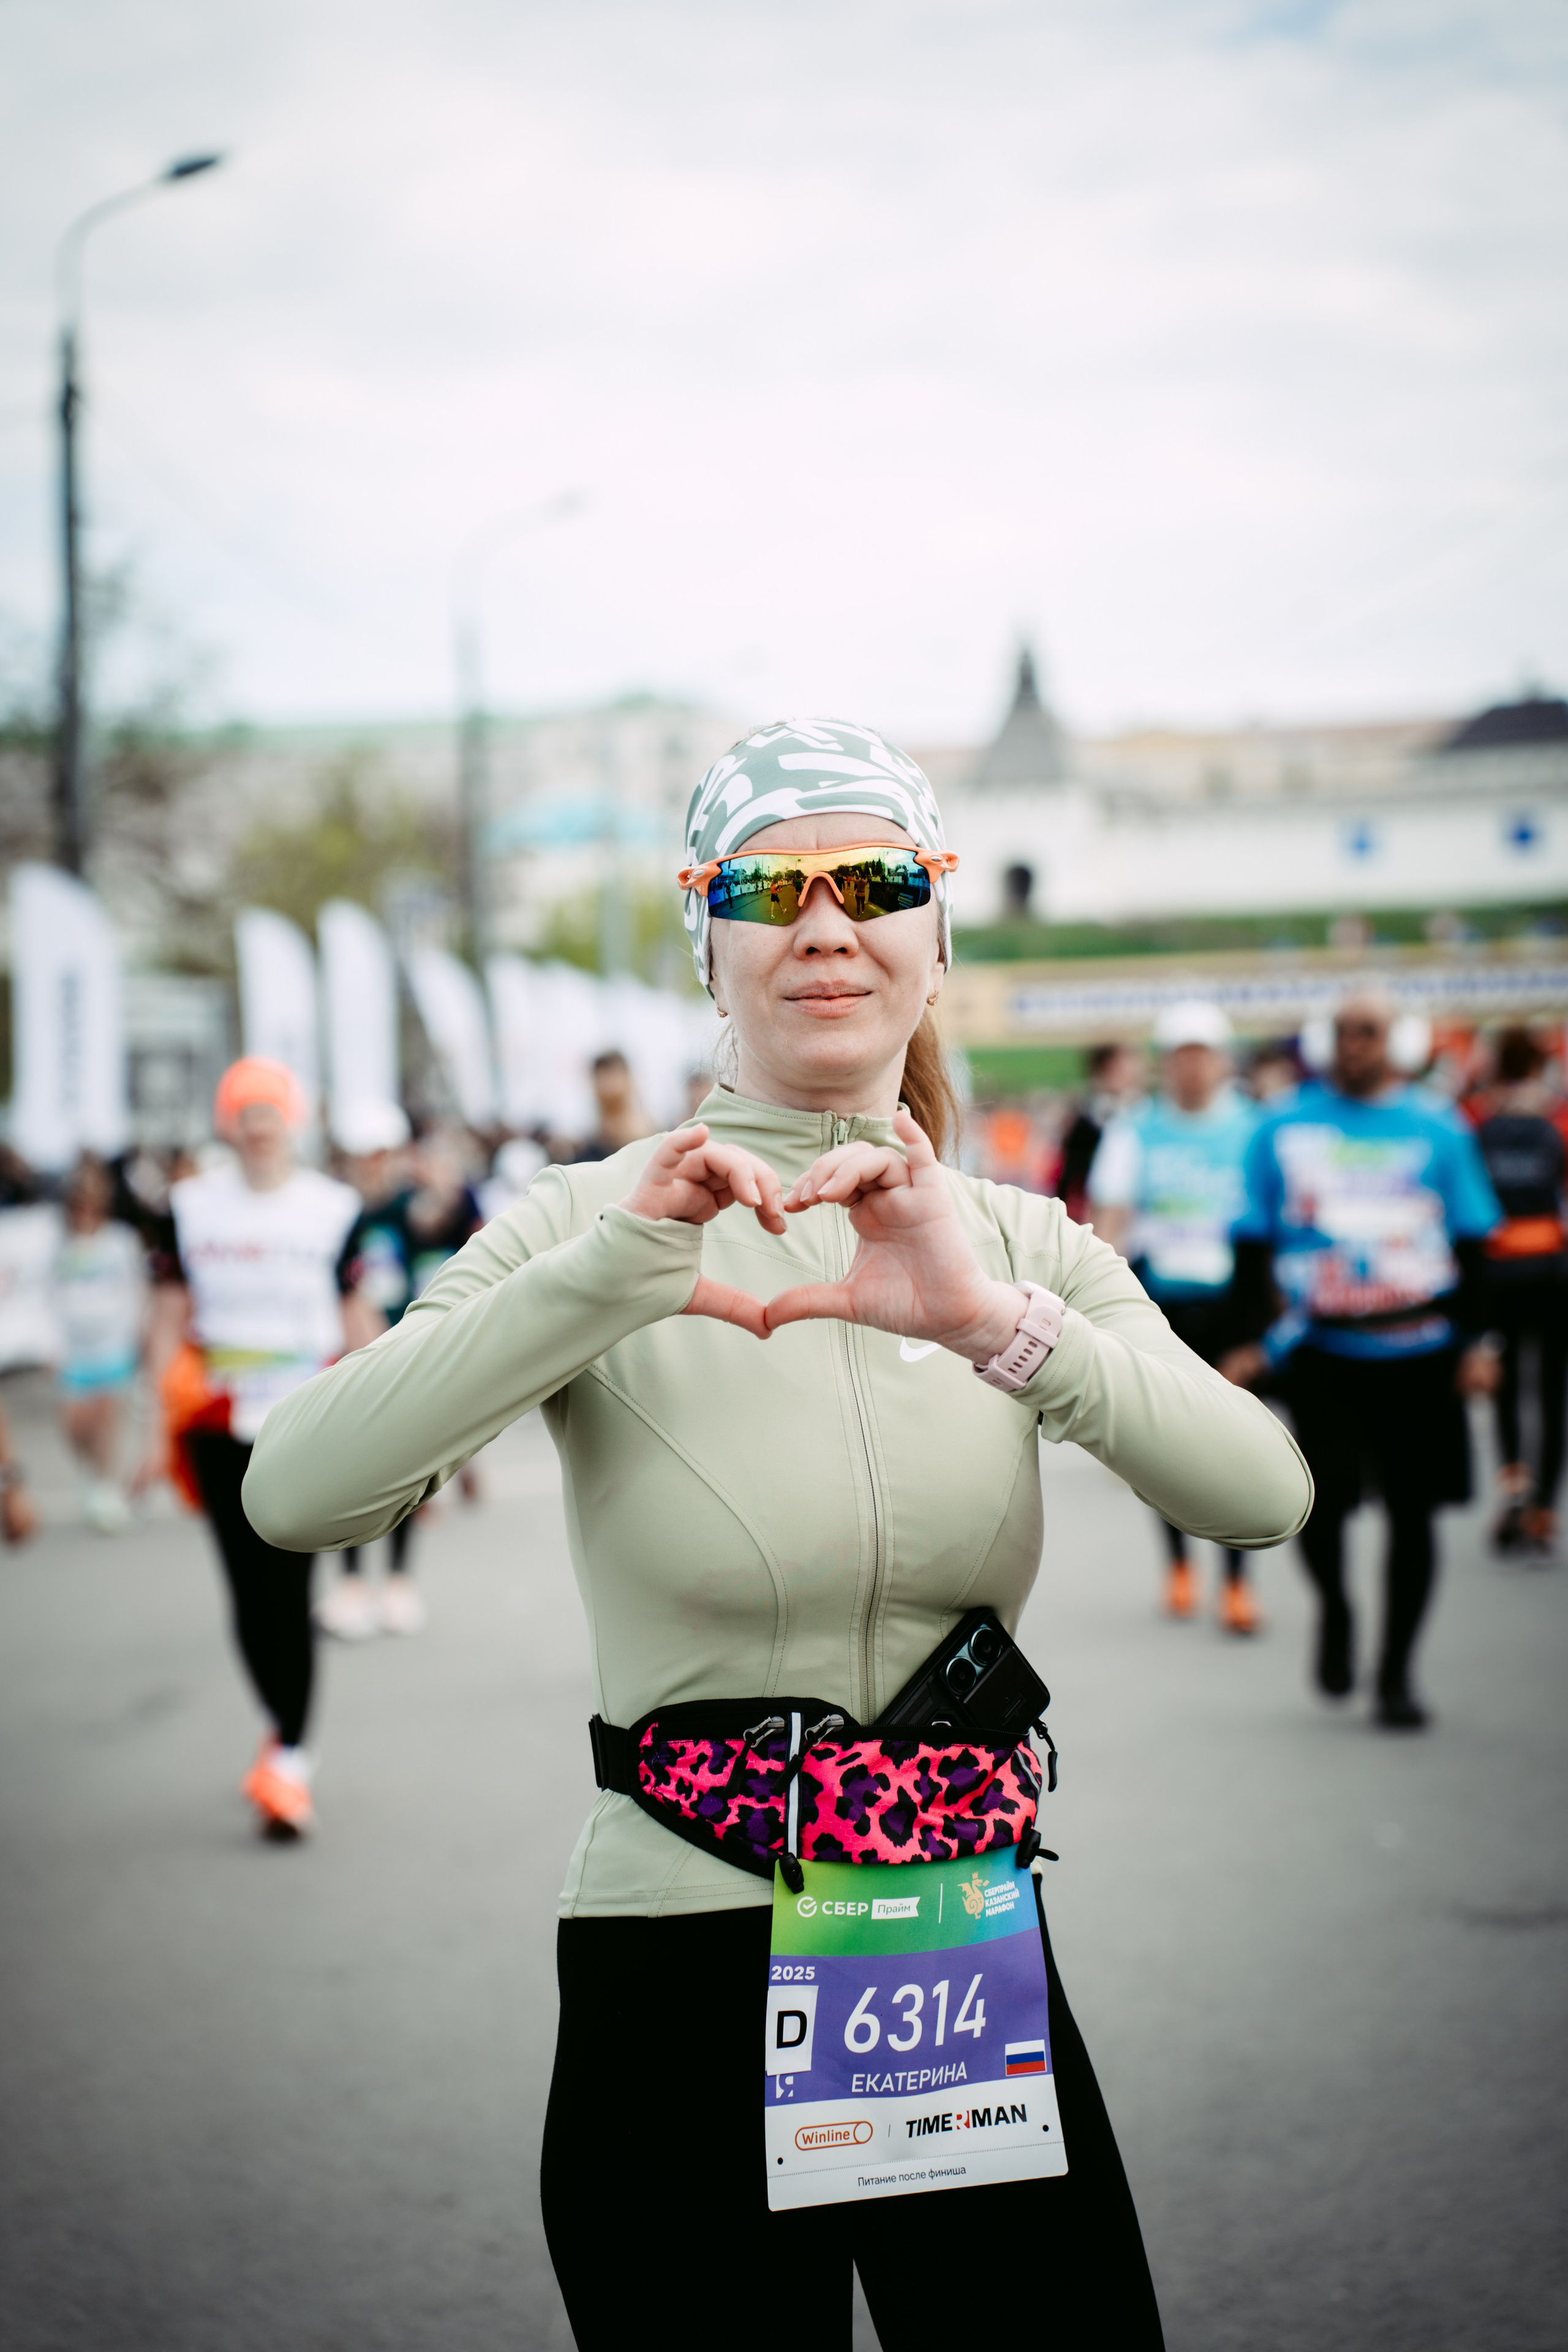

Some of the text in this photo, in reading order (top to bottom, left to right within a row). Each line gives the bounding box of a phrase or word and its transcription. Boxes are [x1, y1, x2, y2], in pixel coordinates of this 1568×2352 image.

[984, 1880, 1016, 1898] СБЕРПРАЙМ
[985, 1888, 1020, 1908] КАЗАНСКИЙ
[821, 1901, 911, 1916] СБЕР Прайм
[986, 1901, 1016, 1918] МАРАФОН
[771, 1965, 816, 1980] 2025
[843, 1973, 987, 2054] 6314
[776, 2010, 808, 2049] D
[851, 2061, 968, 2093] ЕКАТЕРИНА
[802, 2128, 851, 2145] Winline
[858, 2166, 967, 2187] Питание после финиша
